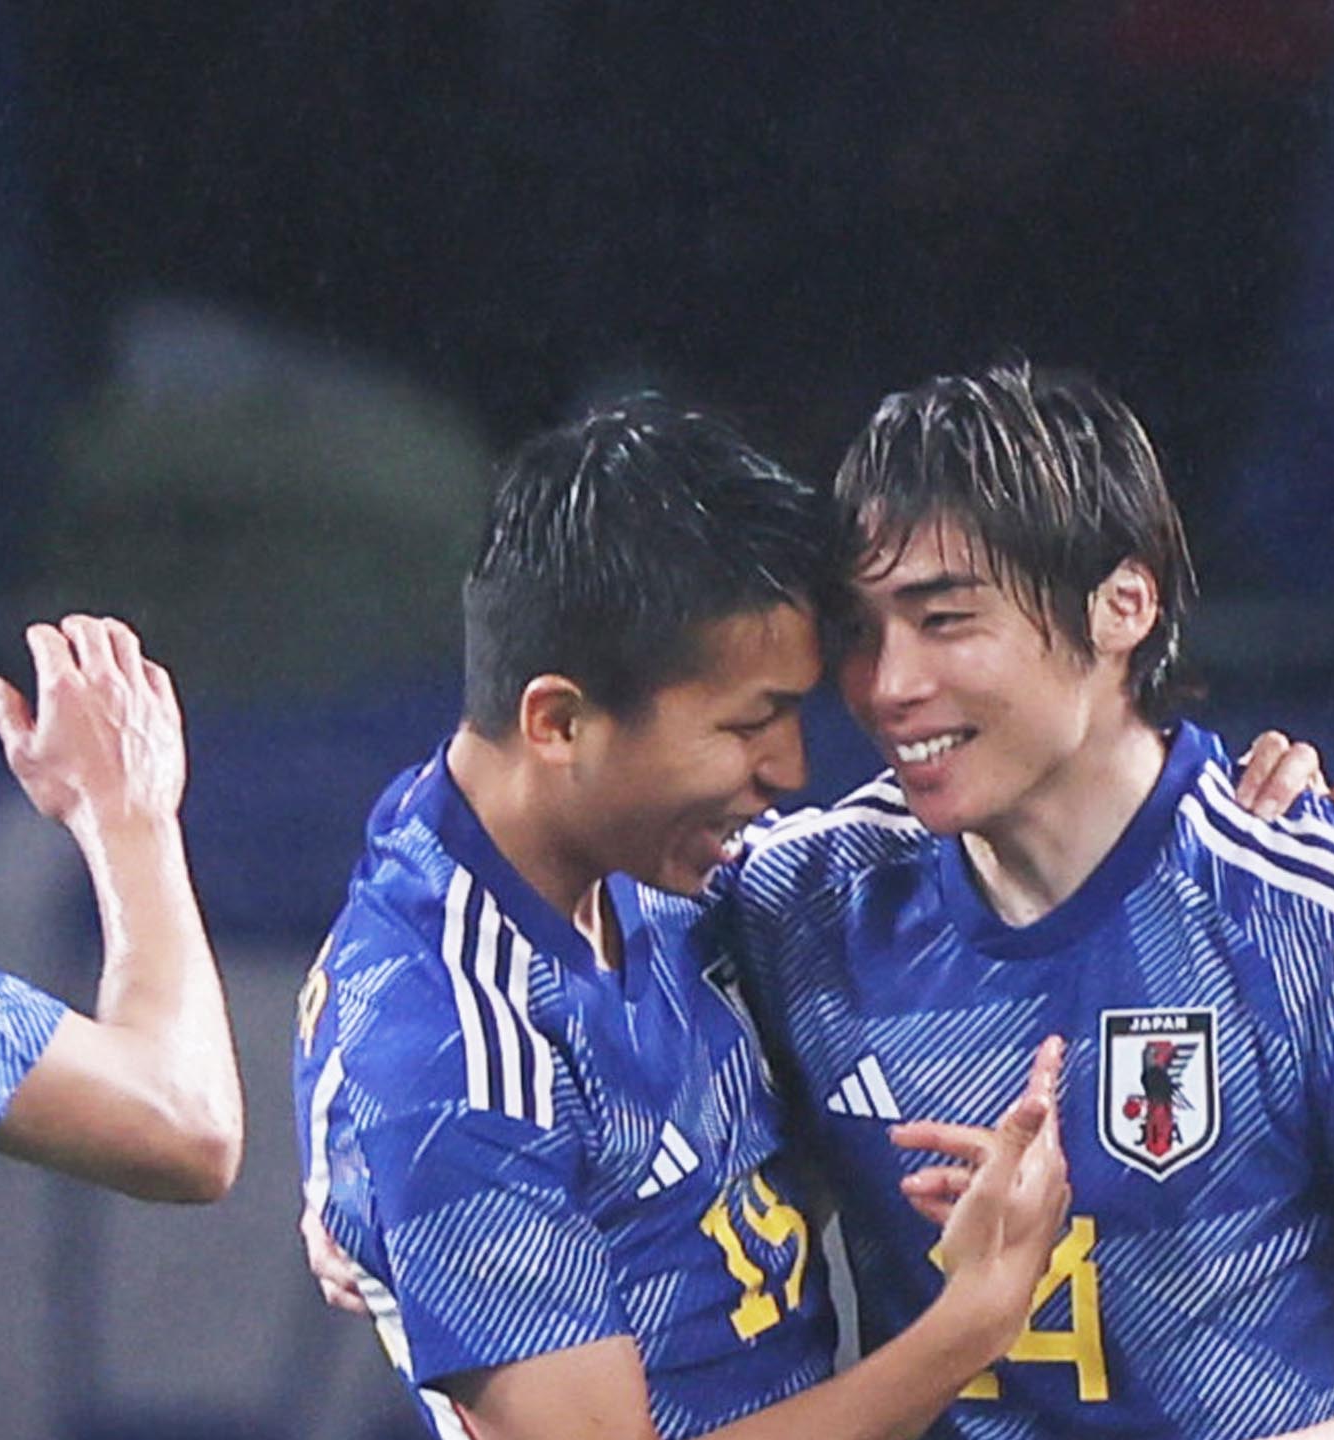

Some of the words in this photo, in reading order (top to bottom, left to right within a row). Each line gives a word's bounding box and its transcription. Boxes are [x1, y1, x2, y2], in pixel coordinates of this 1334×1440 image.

[1129, 1016, 1187, 1031] JAPAN
[701, 1173, 807, 1340] 19
[929, 1216, 1110, 1401] 4
